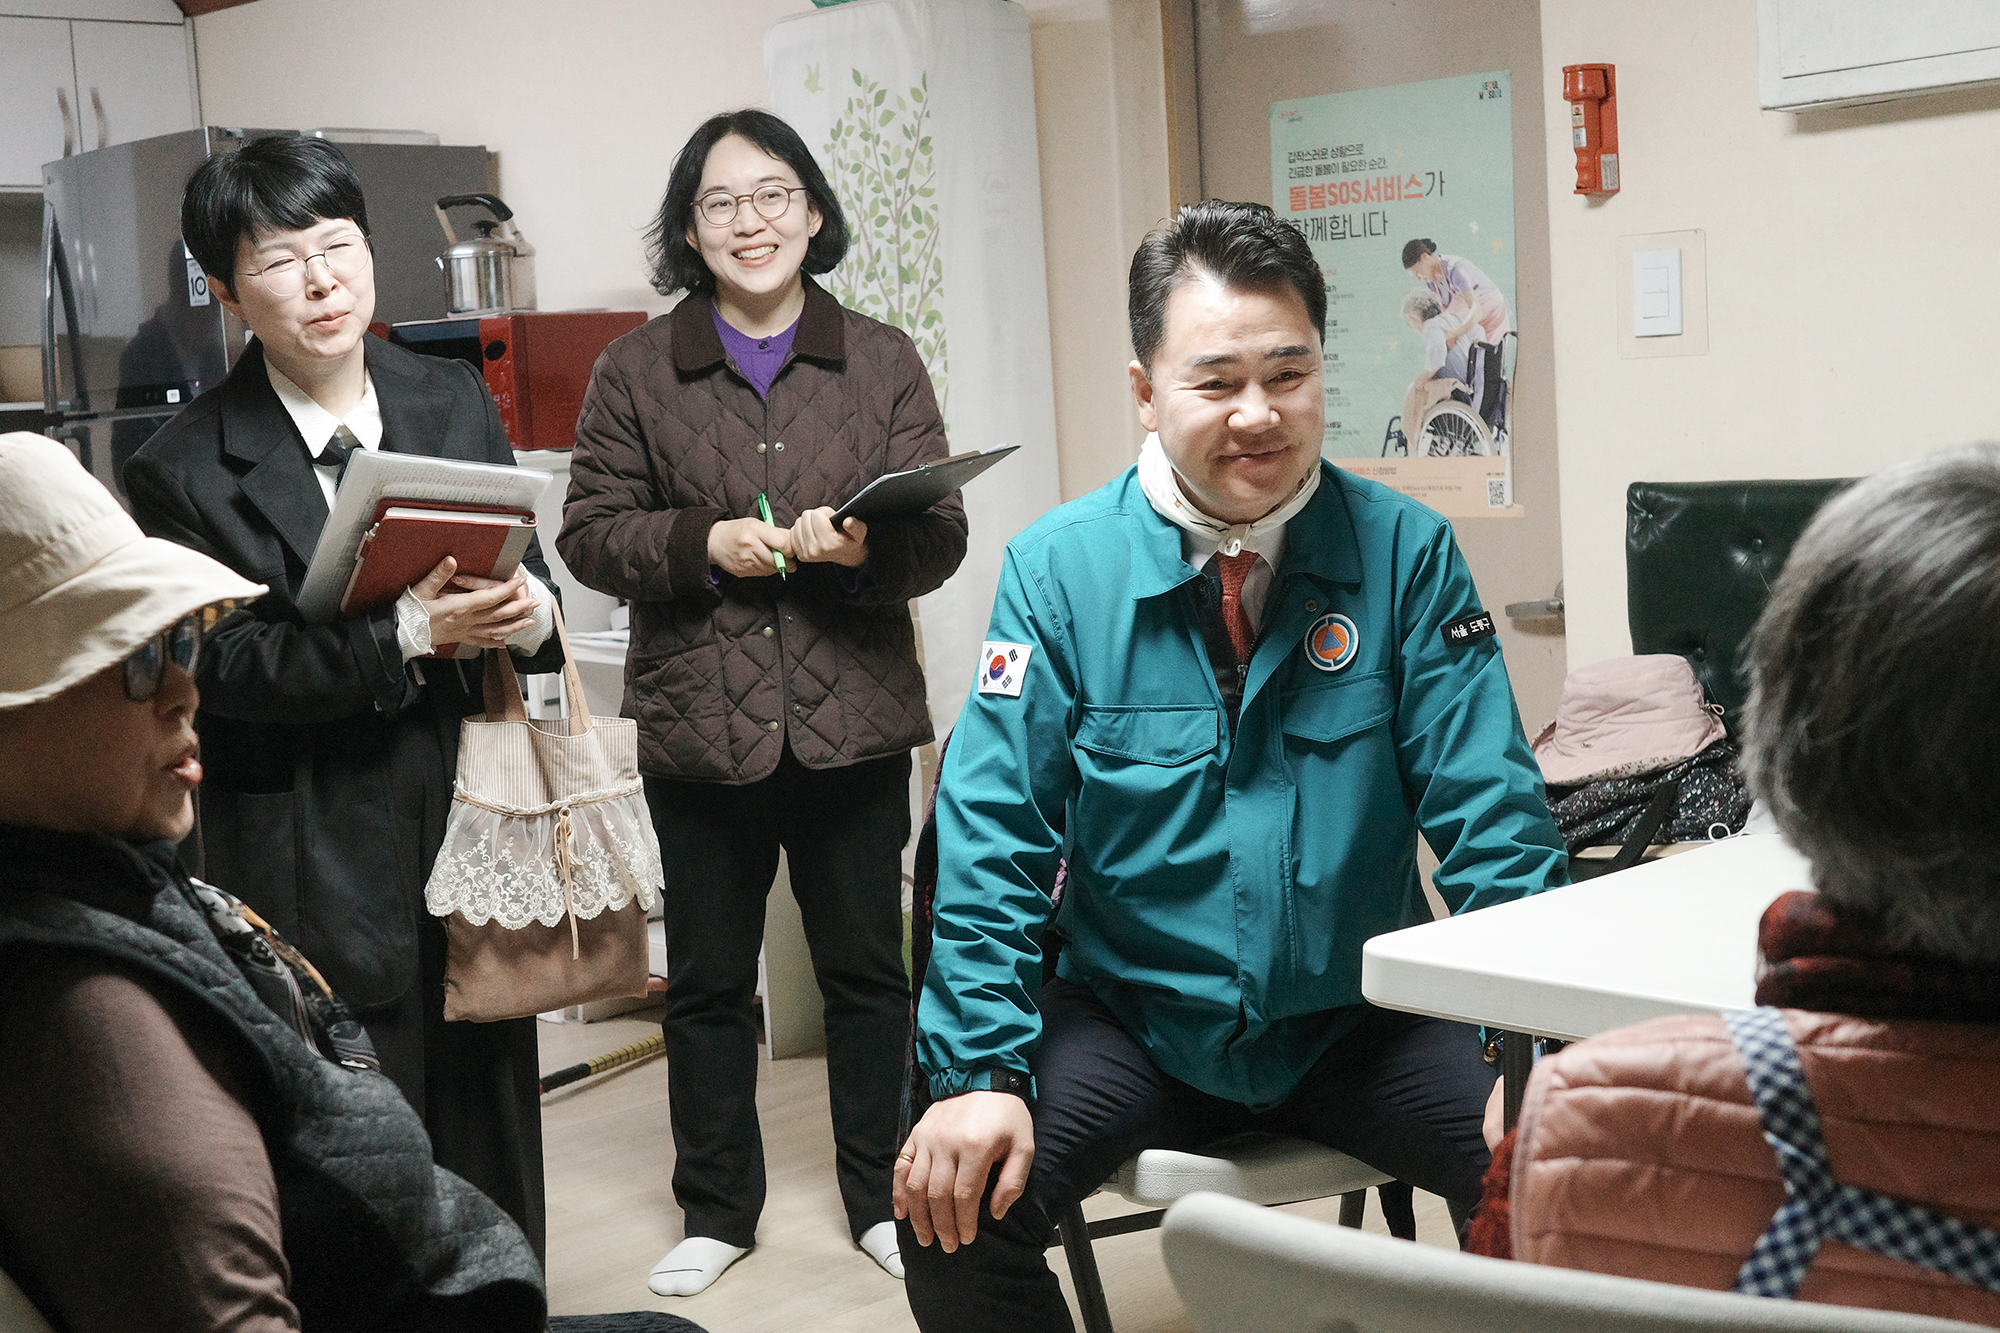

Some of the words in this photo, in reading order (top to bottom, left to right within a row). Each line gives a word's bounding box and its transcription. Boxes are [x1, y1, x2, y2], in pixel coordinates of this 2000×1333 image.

[1288, 148, 1328, 164] 갑작스러운
[1330, 144, 1363, 158] 상황으로
[1289, 165, 1313, 179] 긴급한
[1342, 159, 1367, 173] 필요한
[1289, 170, 1445, 212] 돌봄SOS서비스가
[190, 276, 206, 296] 10
[1450, 624, 1468, 639] 서울
[1469, 617, 1490, 633] 도봉구
